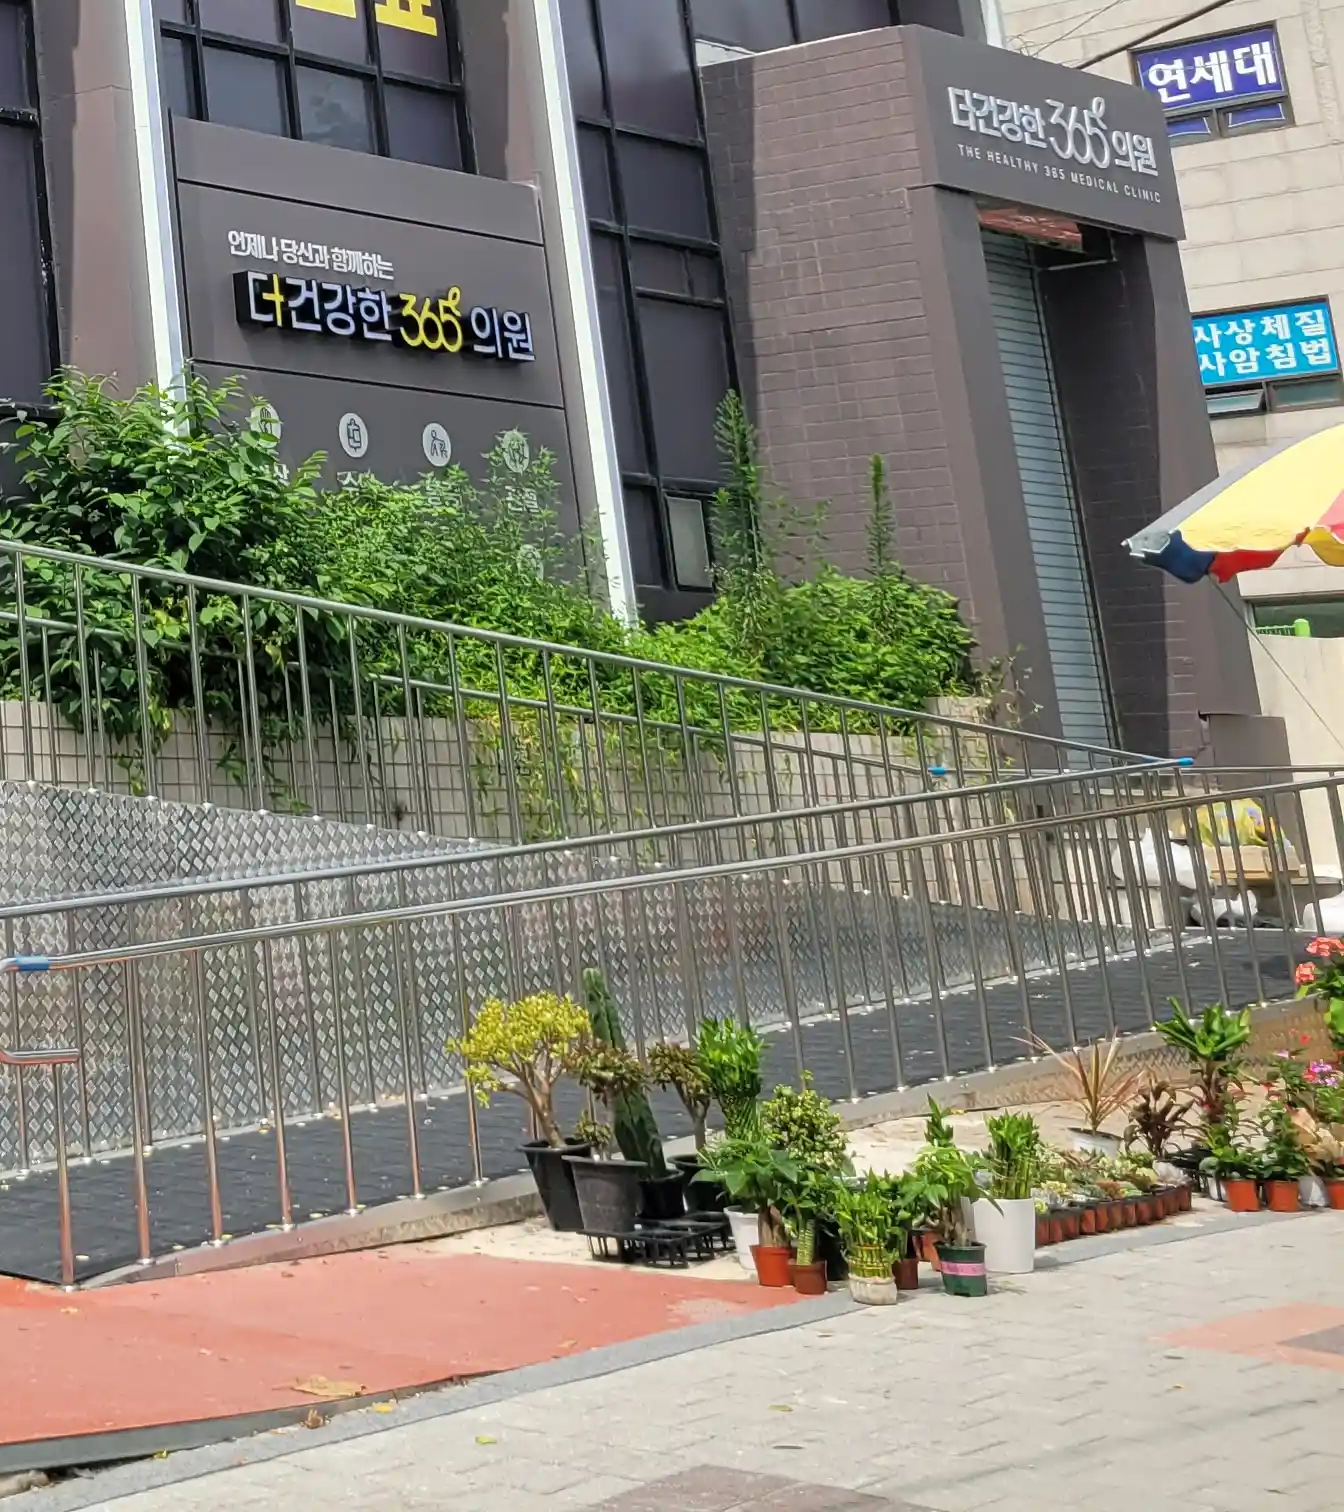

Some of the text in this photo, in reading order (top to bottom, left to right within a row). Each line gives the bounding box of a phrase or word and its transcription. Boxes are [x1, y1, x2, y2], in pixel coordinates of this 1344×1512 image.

[1148, 41, 1278, 104] 연세대
[947, 86, 1160, 177] 더건강한 365 의원
[957, 143, 982, 160] THE
[987, 149, 1039, 174] HEALTHY
[1070, 171, 1120, 195] MEDICAL
[1123, 184, 1162, 204] CLINIC
[227, 230, 396, 281] 언제나 당신과 함께하는
[246, 271, 537, 362] 더건강한 365 의원
[1193, 309, 1327, 349] 사상체질
[1199, 338, 1332, 377] 사암침법
